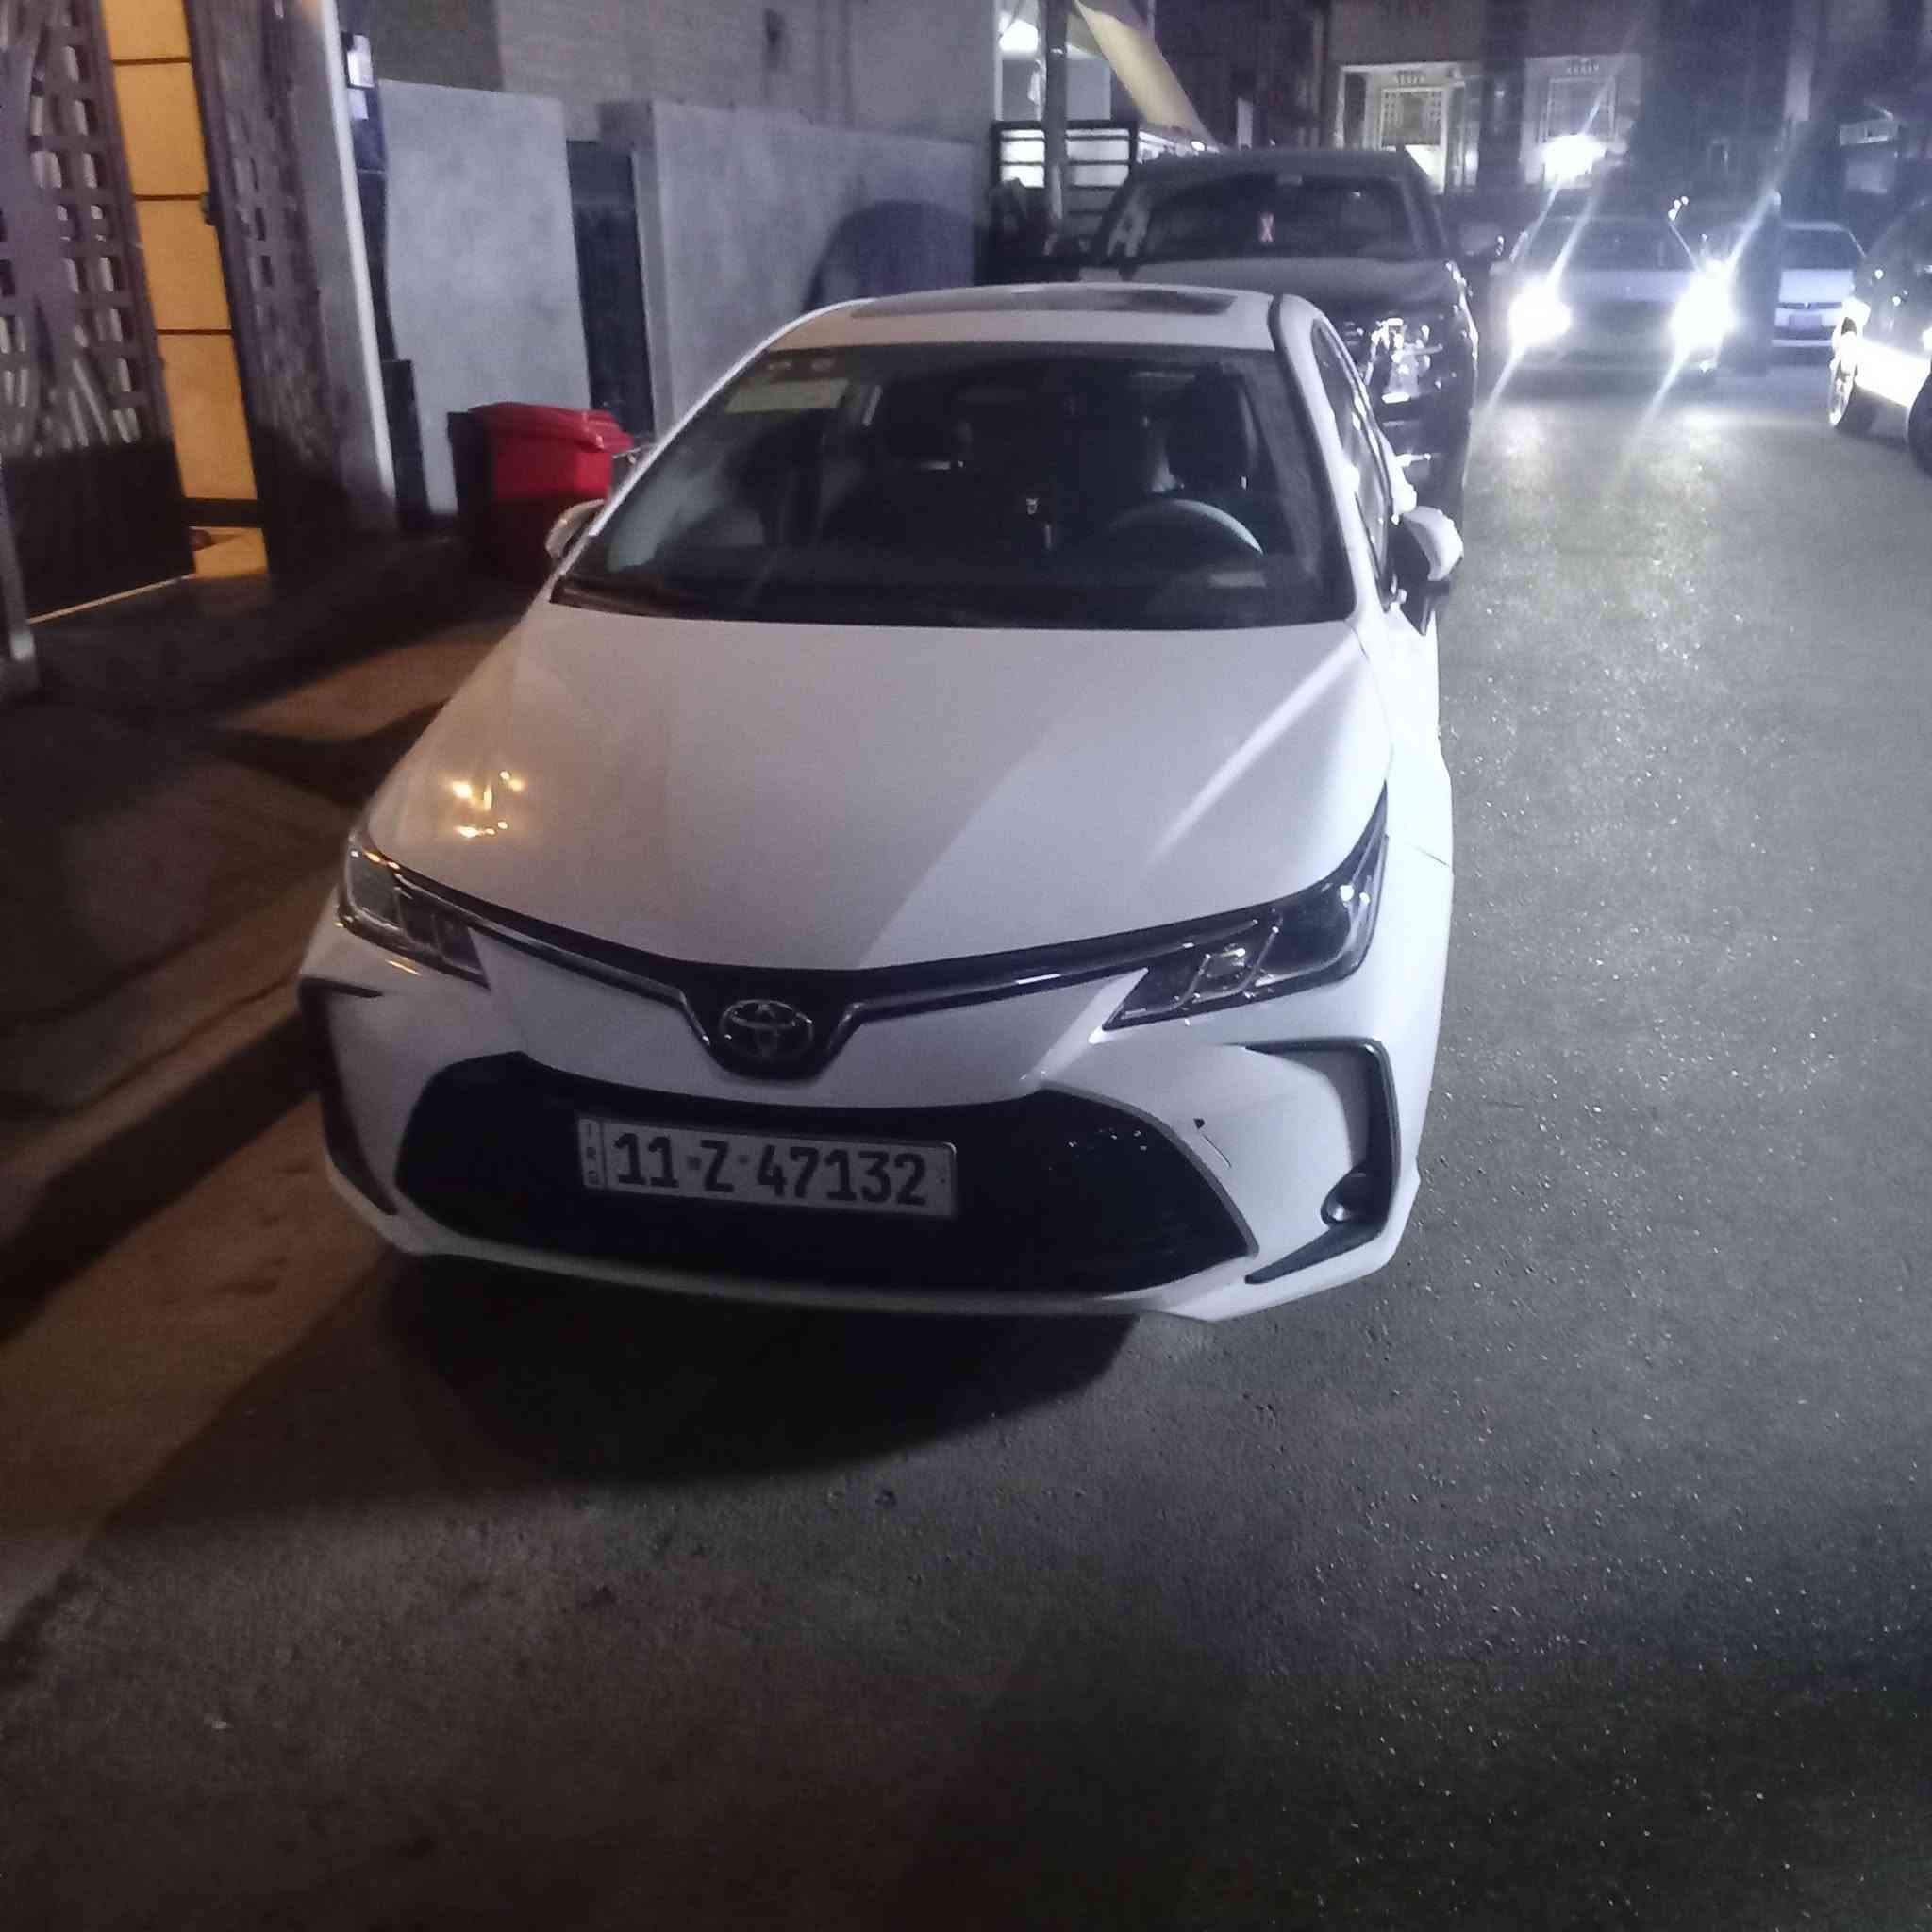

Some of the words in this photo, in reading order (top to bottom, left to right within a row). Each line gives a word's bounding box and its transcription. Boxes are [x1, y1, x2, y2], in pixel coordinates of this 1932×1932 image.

[612, 1132, 679, 1189] 11
[700, 1139, 734, 1192] Z
[757, 1144, 927, 1205] 47132
